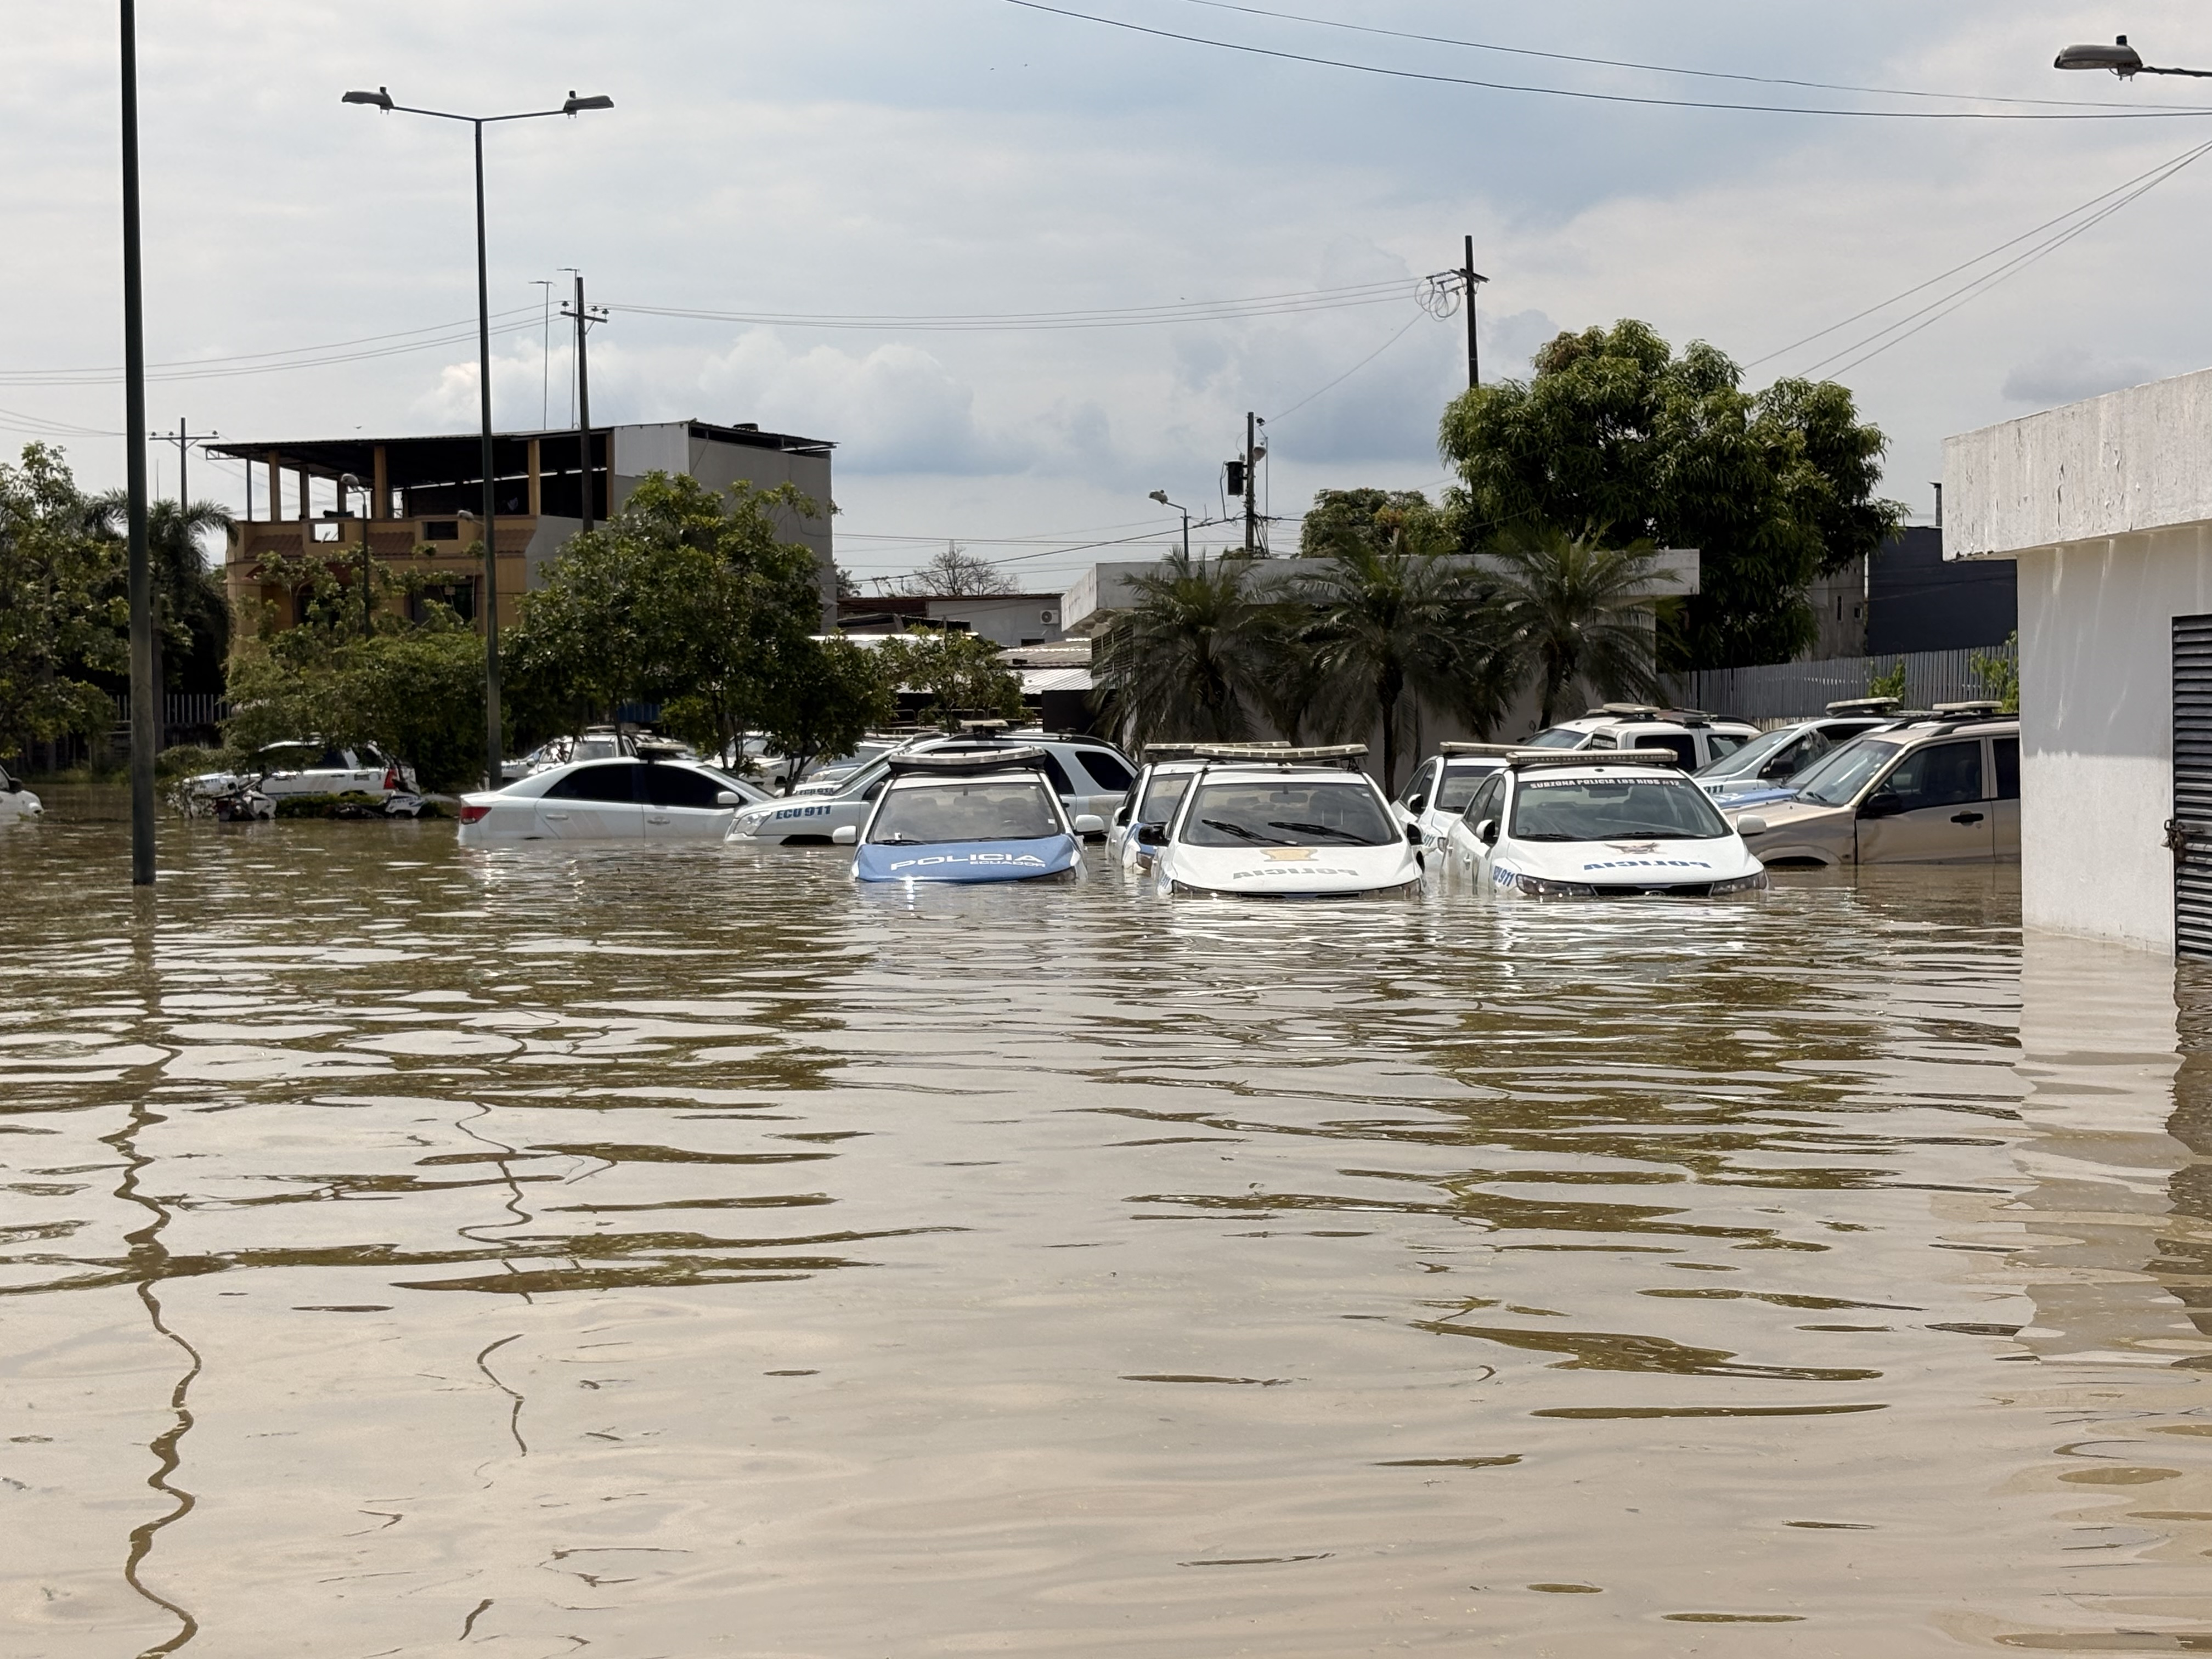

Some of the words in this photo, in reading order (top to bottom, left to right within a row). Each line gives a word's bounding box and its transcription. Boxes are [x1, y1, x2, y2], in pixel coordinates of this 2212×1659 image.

[1530, 780, 1576, 789] SUBZONA
[776, 808, 802, 820] ECU
[805, 805, 831, 816] 911
[891, 854, 1045, 871] POLICIA
[1498, 869, 1515, 887] 911
